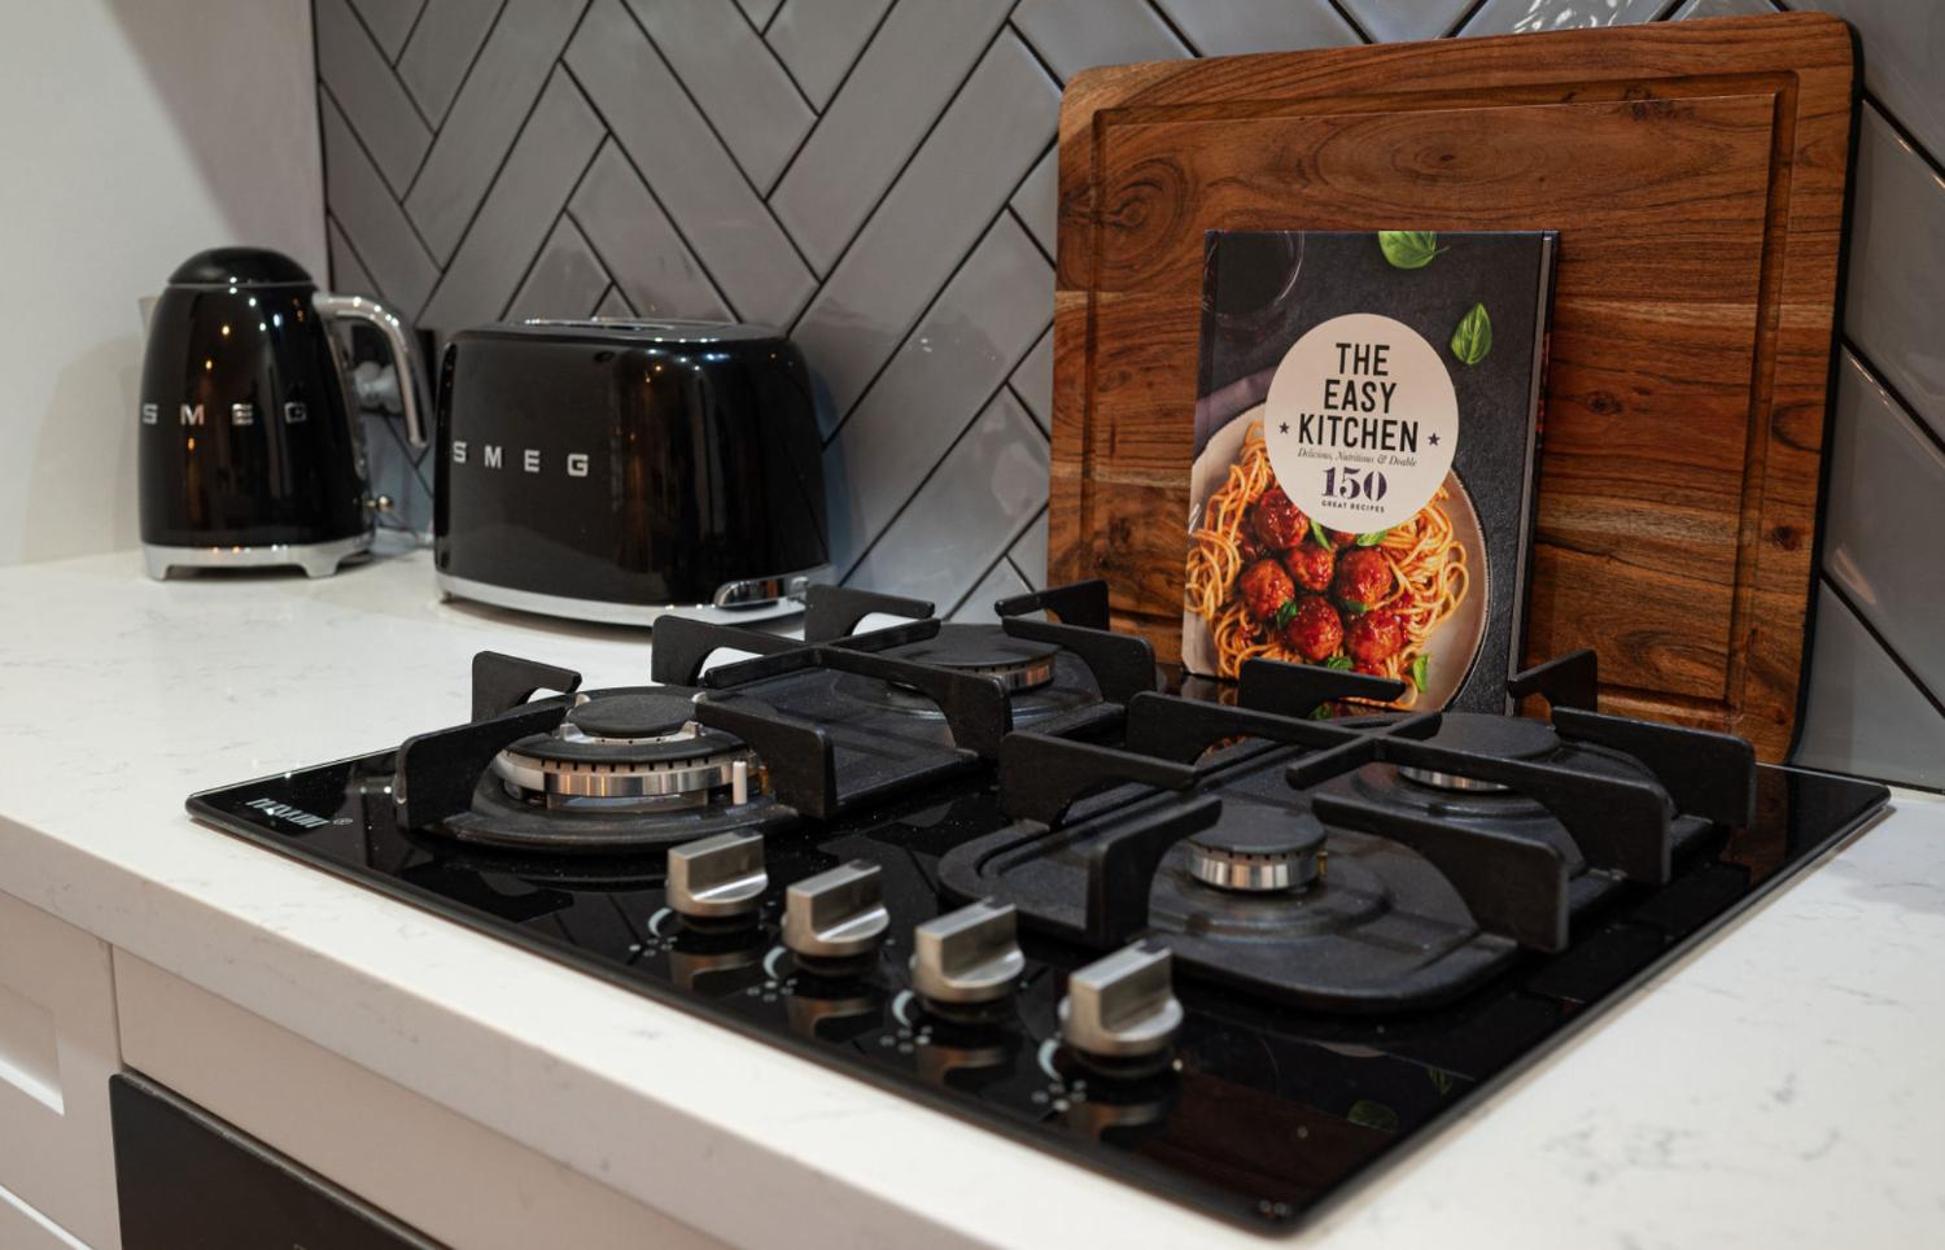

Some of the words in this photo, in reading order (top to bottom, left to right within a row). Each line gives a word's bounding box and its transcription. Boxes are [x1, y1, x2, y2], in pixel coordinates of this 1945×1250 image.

[1335, 343, 1390, 376] THE
[1324, 378, 1397, 414] EASY
[142, 402, 307, 425] SMEG
[1298, 413, 1418, 452] KITCHEN
[453, 440, 589, 477] SMEG
[1377, 453, 1388, 464] &
[1321, 466, 1387, 501] 150
[1321, 500, 1347, 509] GREAT
[1350, 502, 1385, 513] RECIPES
